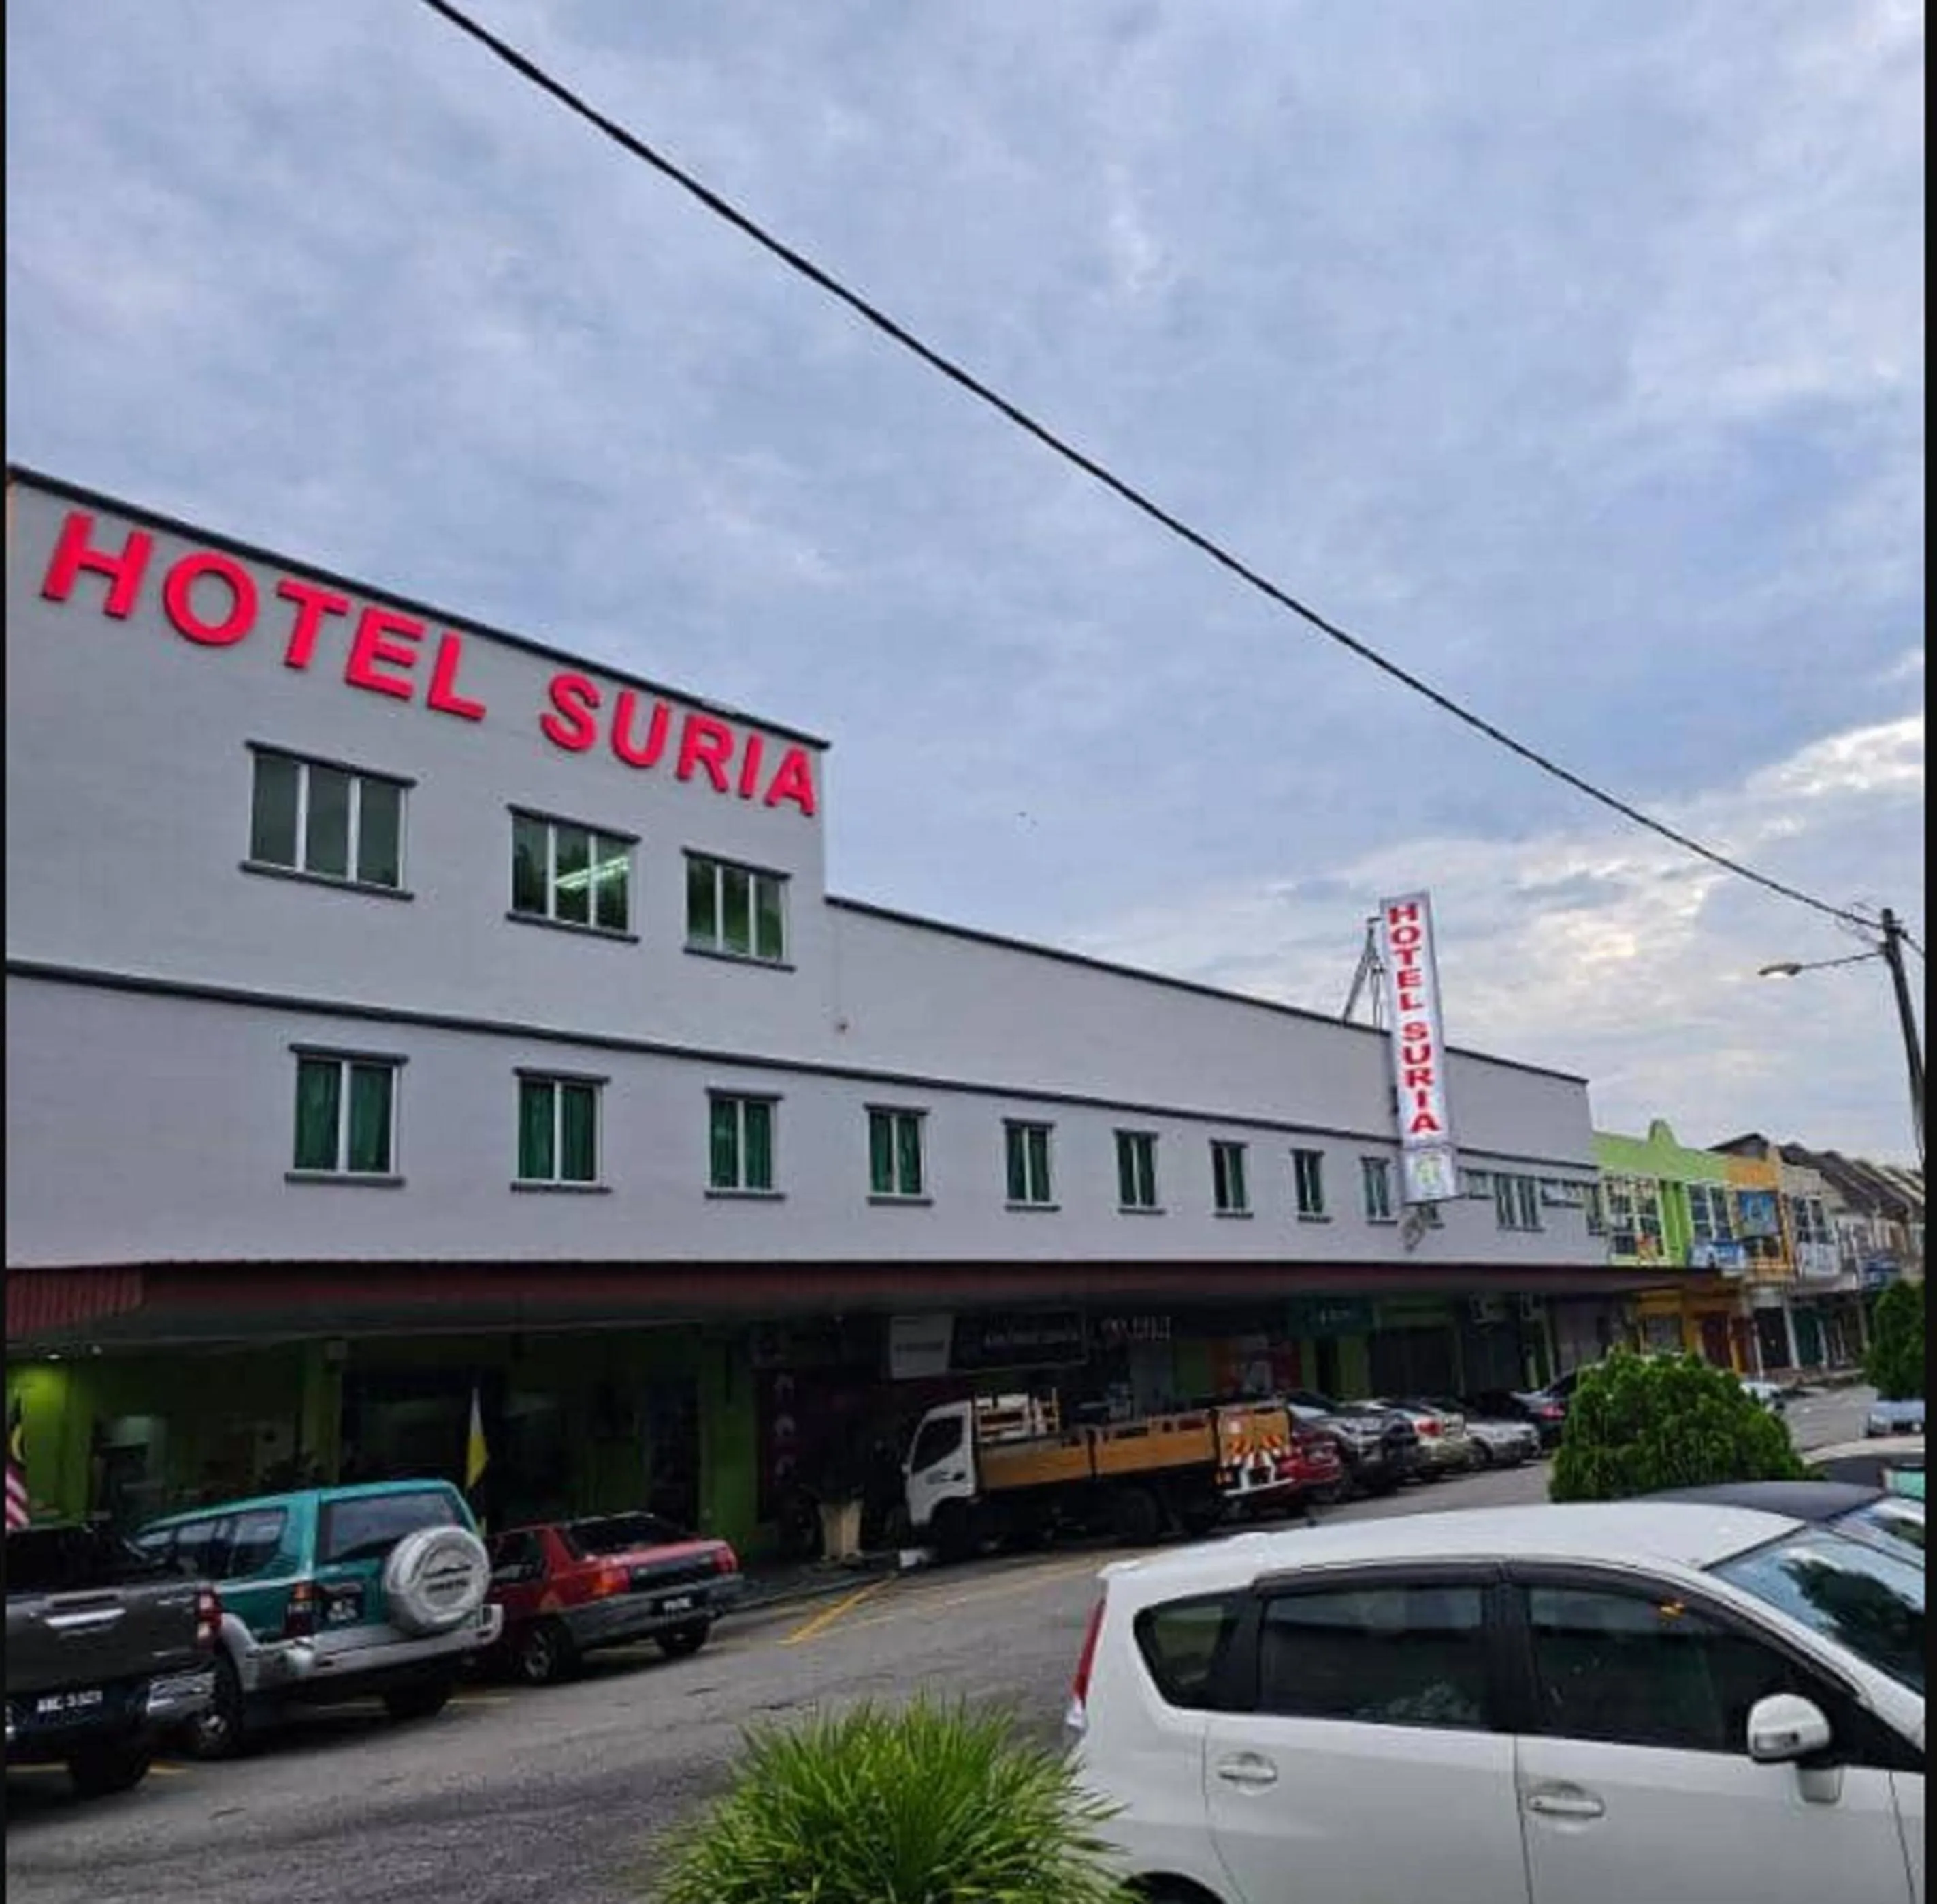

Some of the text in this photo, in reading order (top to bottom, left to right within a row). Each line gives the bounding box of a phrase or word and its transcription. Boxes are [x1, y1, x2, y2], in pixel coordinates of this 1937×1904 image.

[42, 511, 817, 816] HOTEL SURIA
[1388, 903, 1439, 1133] HOTEL SURIA
